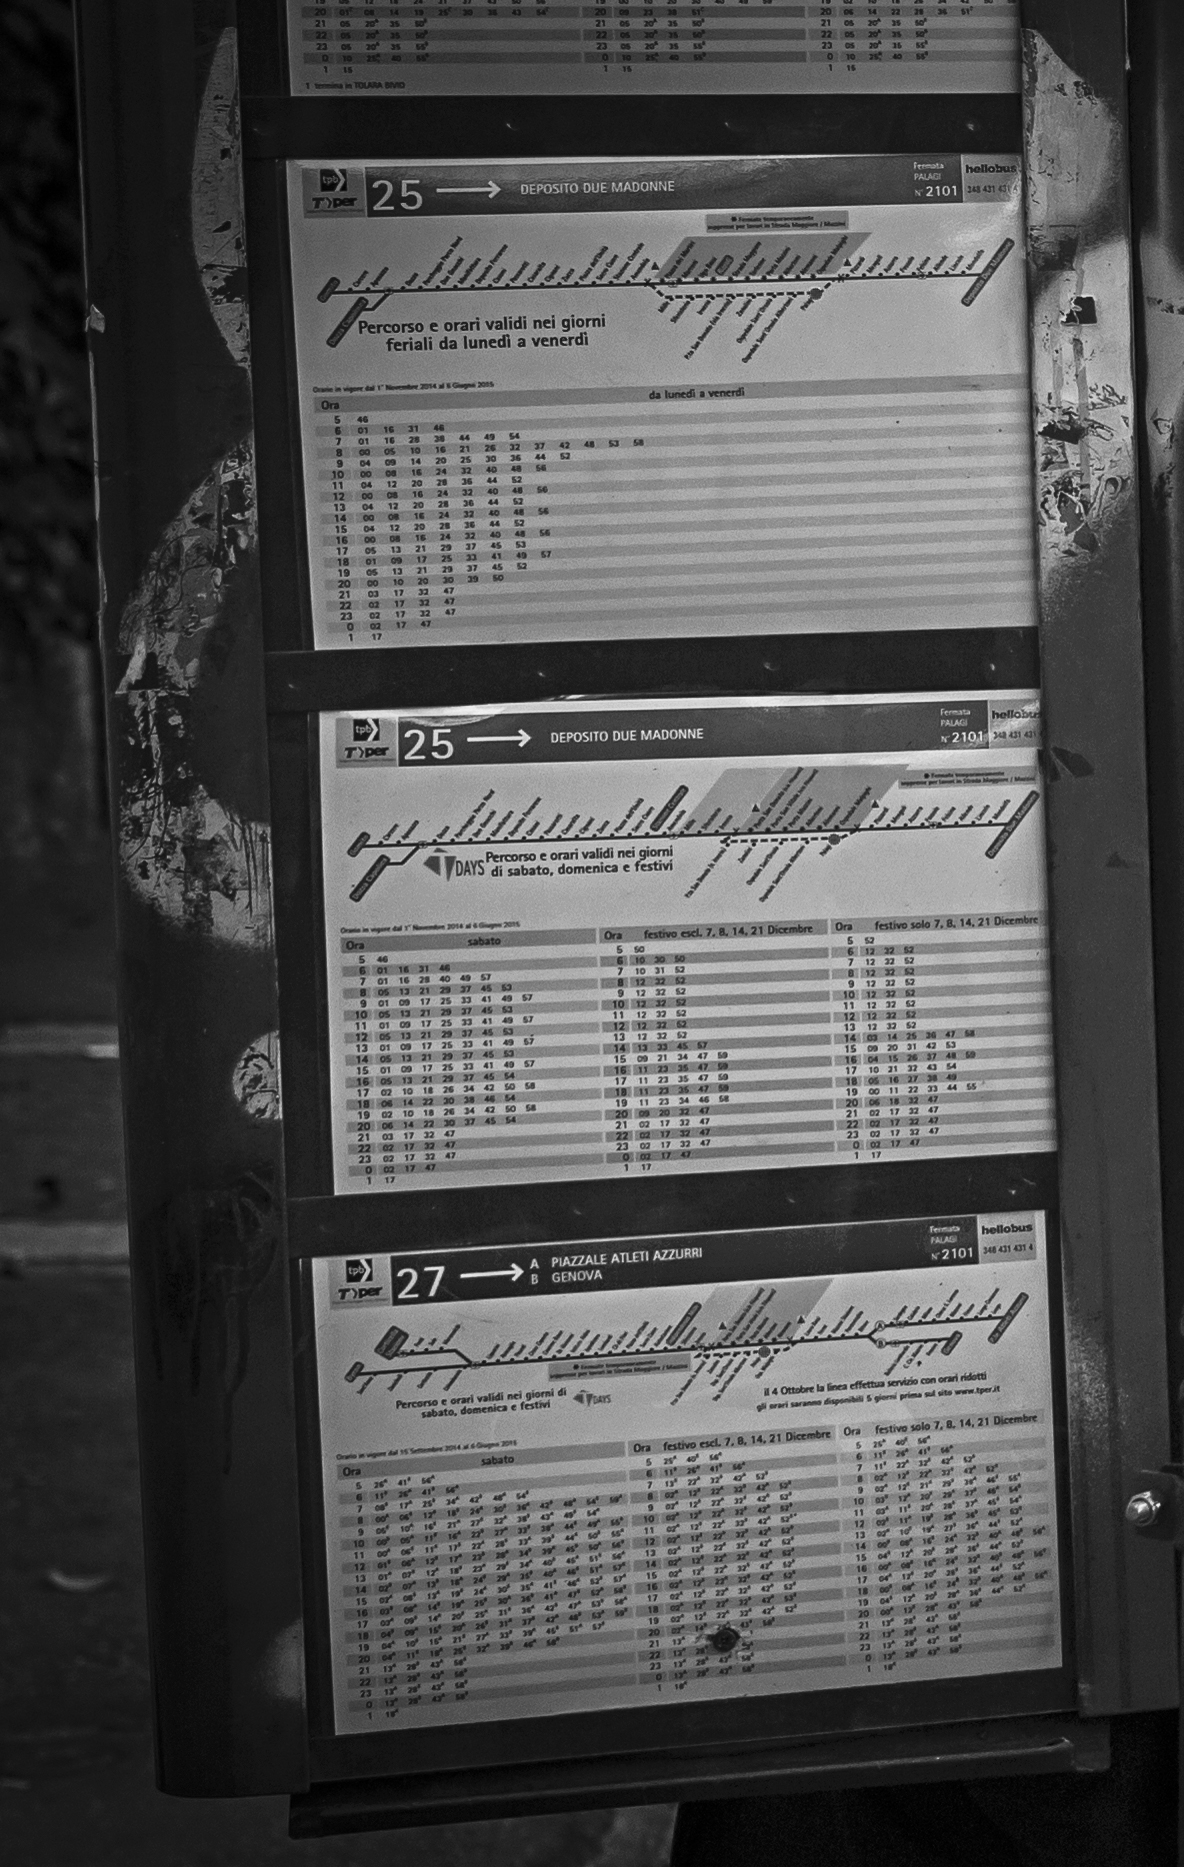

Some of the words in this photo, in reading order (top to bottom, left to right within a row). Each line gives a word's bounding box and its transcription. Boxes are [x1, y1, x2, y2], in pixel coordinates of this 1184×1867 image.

[966, 164, 1017, 174] hellobus
[372, 180, 423, 210] 25
[520, 183, 579, 195] DEPOSITO
[583, 182, 607, 193] DUE
[611, 181, 675, 193] MADONNE
[926, 185, 957, 197] 2101
[358, 320, 424, 334] Percorso
[429, 322, 439, 332] e
[444, 317, 480, 331] orari
[485, 316, 527, 330] validi
[533, 315, 556, 329] nei
[561, 313, 606, 332] giorni
[386, 337, 433, 352] feriali
[439, 336, 458, 350] da
[463, 334, 511, 349] lunedì
[517, 337, 527, 348] a
[531, 331, 589, 347] venerdì
[649, 390, 661, 400] da
[664, 389, 695, 399] lunedì
[699, 390, 705, 398] a
[707, 387, 745, 397] venerdì
[321, 400, 340, 410] Ora
[334, 415, 341, 424] 5
[335, 426, 341, 435] 6
[433, 424, 445, 432] 46
[940, 708, 971, 716] Fermata
[355, 725, 371, 735] tpb
[941, 719, 968, 727] PALAGI
[550, 731, 608, 743] DEPOSITO
[612, 730, 636, 742] DUE
[640, 728, 704, 741] MADONNE
[952, 730, 983, 743] 2101
[404, 728, 454, 760] 25
[485, 852, 536, 863] Percorso
[540, 852, 547, 860] e
[550, 848, 579, 860] orari
[582, 847, 614, 859] validi
[618, 846, 635, 858] nei
[639, 845, 674, 860] giorni
[456, 860, 485, 876] DAYS
[491, 865, 503, 877] di
[508, 865, 554, 877] sabato,
[558, 862, 619, 875] domenica
[623, 864, 630, 872] e
[635, 860, 673, 872] festivi
[835, 922, 853, 931] Ora
[875, 920, 908, 931] festivo
[911, 920, 931, 930] solo
[978, 917, 990, 927] 21
[994, 915, 1039, 926] Dicembre
[604, 930, 622, 940] Ora
[644, 929, 677, 939] festivo
[751, 926, 763, 935] 21
[767, 924, 813, 935] Dicembre
[346, 940, 365, 950] Ora
[468, 937, 501, 947] sabato
[847, 936, 853, 945] 5
[864, 937, 875, 945] 52
[847, 948, 854, 956] 6
[865, 948, 875, 956] 12
[903, 946, 915, 954] 52
[982, 1224, 1033, 1235] hellobus
[942, 1247, 973, 1259] 2101
[998, 1245, 1011, 1253] 431
[1013, 1244, 1026, 1252] 431
[1029, 1243, 1033, 1251] 4
[529, 1258, 539, 1269] A
[551, 1254, 607, 1268] PIAZZALE
[611, 1250, 649, 1264] ATLETI
[653, 1247, 703, 1261] AZZURRI
[348, 1266, 365, 1276] tpb
[531, 1273, 539, 1285] B
[551, 1269, 603, 1283] GENOVA
[397, 1265, 445, 1298] 27
[764, 1388, 770, 1396] il
[781, 1385, 814, 1395] Ottobre
[816, 1384, 824, 1392] la
[827, 1382, 847, 1391] linea
[850, 1380, 885, 1390] effettua
[887, 1377, 918, 1387] servizio
[920, 1376, 936, 1384] con
[938, 1374, 958, 1383] orari
[960, 1371, 987, 1382] ridotti
[396, 1399, 438, 1409] Percorso
[450, 1394, 474, 1405] orari
[477, 1392, 504, 1403] validi
[507, 1390, 522, 1400] nei
[526, 1388, 555, 1401] giorni
[557, 1387, 567, 1396] di
[421, 1408, 457, 1418] sabato,
[460, 1404, 508, 1415] domenica
[520, 1399, 550, 1410] festivi
[843, 1426, 861, 1436] Ora
[875, 1424, 908, 1435] festivo
[910, 1421, 930, 1432] solo
[977, 1417, 990, 1427] 21
[993, 1413, 1037, 1425] Dicembre
[633, 1443, 651, 1453] Ora
[663, 1441, 696, 1452] festivo
[769, 1433, 781, 1443] 21
[786, 1430, 831, 1442] Dicembre
[342, 1466, 361, 1477] Ora
[481, 1455, 514, 1466] sabato
